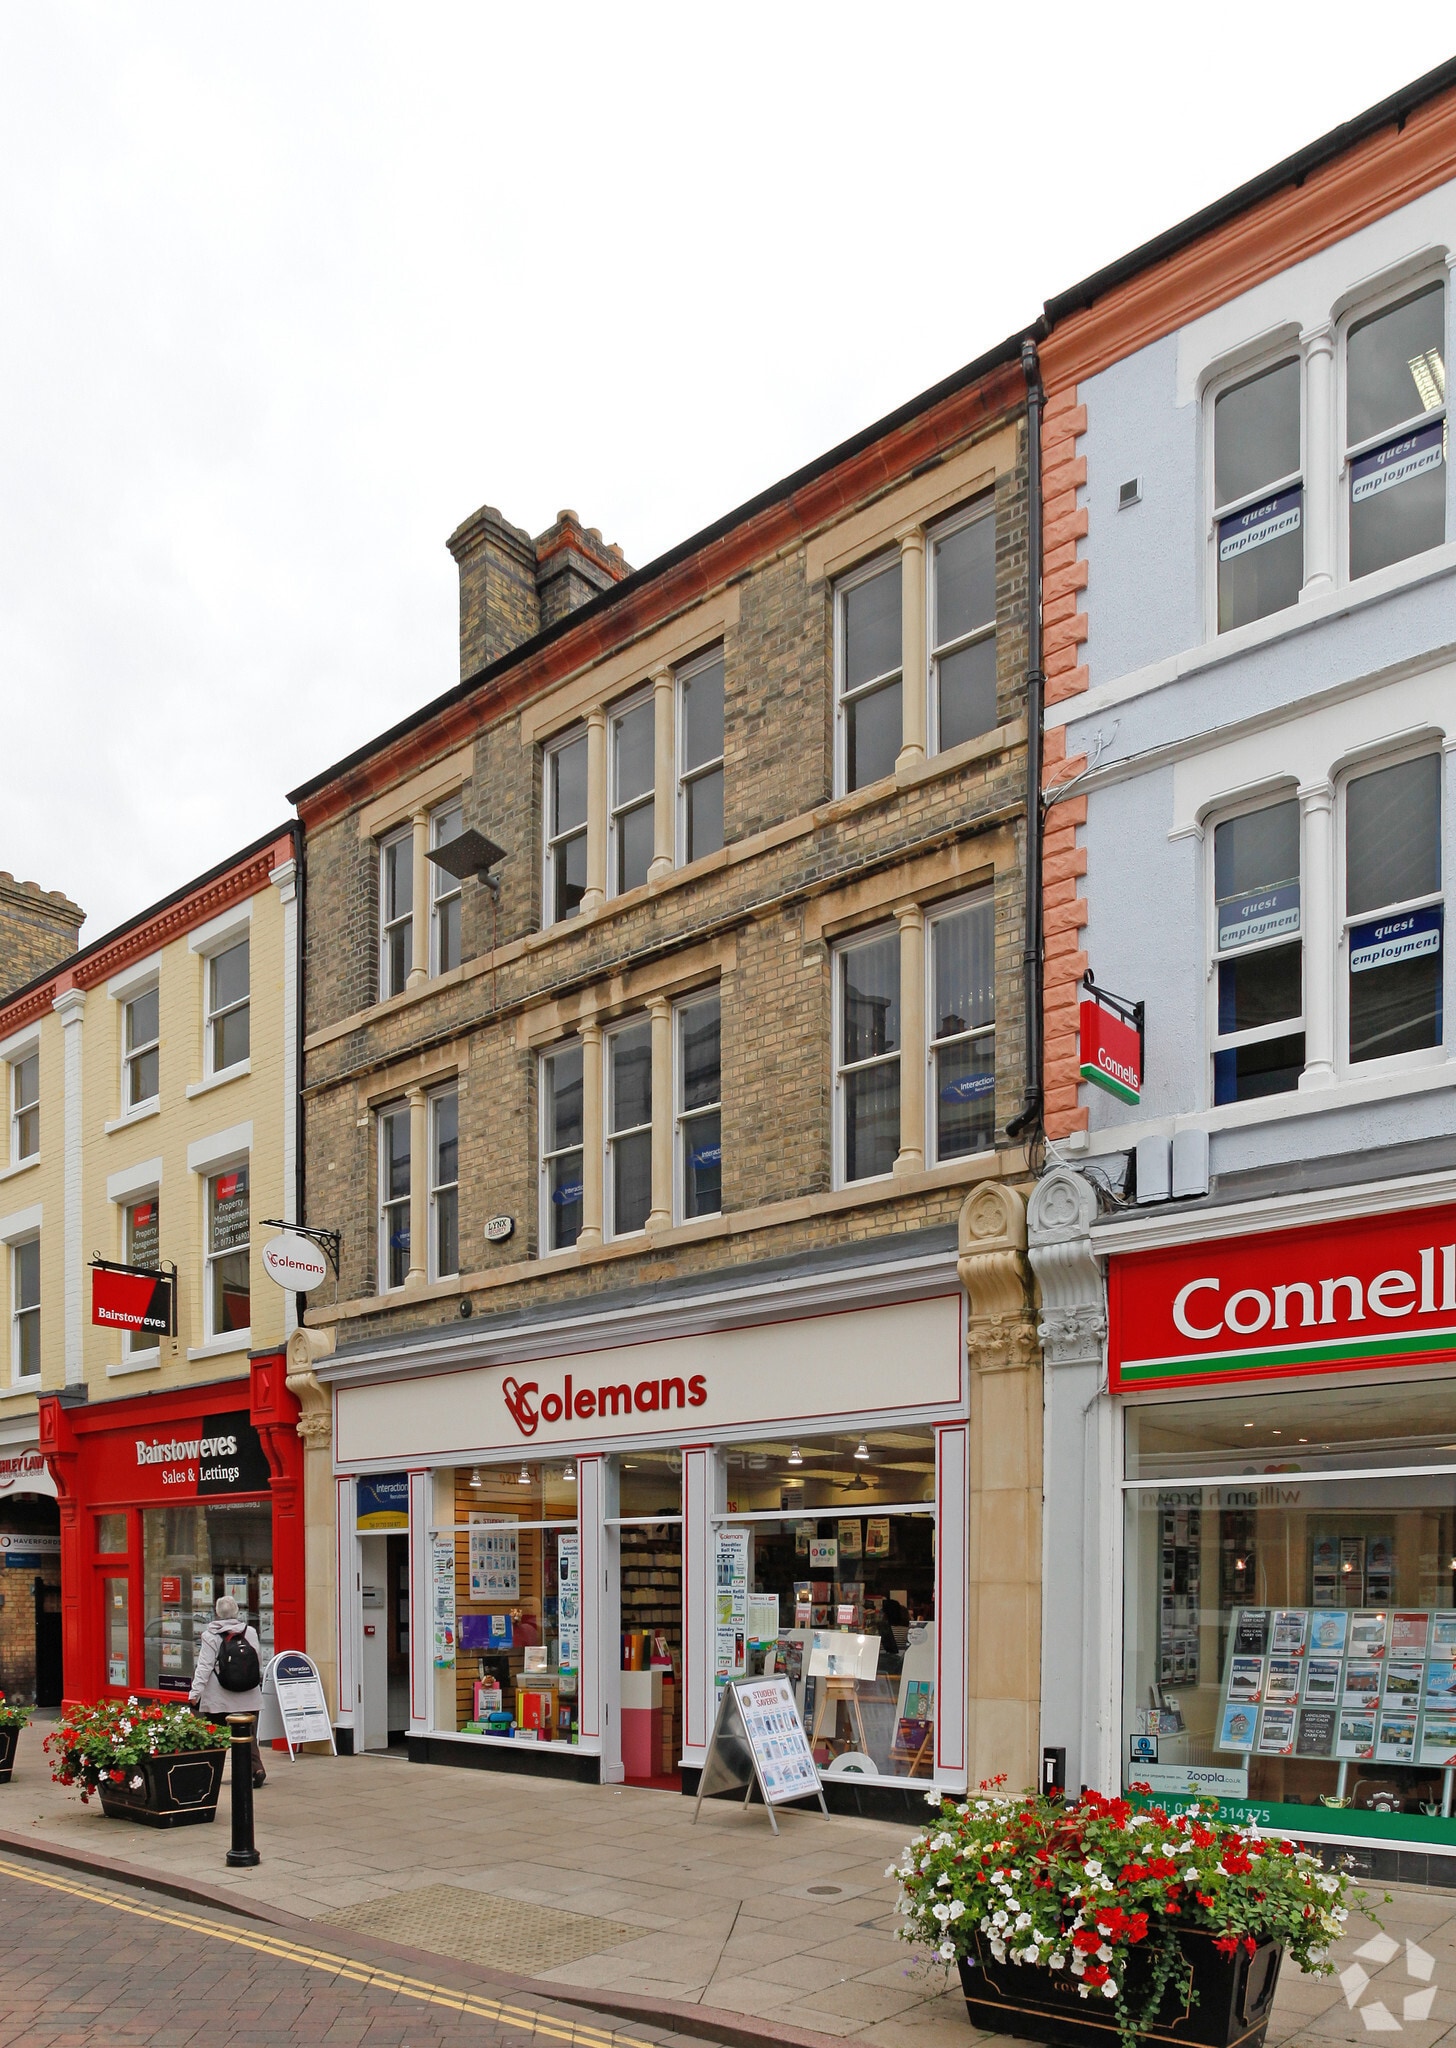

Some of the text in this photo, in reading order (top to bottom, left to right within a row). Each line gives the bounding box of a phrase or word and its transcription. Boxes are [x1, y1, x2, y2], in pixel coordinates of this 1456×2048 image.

[1377, 436, 1417, 465] quest
[1354, 449, 1441, 496] employment
[1241, 500, 1278, 526] quest
[1221, 512, 1299, 555] employment
[1241, 896, 1277, 917] quest
[1221, 912, 1298, 942] employment
[1374, 917, 1415, 939] quest
[1352, 935, 1438, 965] employment
[1097, 1047, 1139, 1088] Connells
[960, 1076, 995, 1091] Interaction
[218, 1199, 244, 1212] Property
[214, 1208, 249, 1225] Management
[488, 1219, 507, 1231] LYNX
[135, 1227, 157, 1239] Property
[214, 1220, 249, 1236] Department
[266, 1250, 325, 1275] Colemans
[1172, 1243, 1456, 1340] Connell
[502, 1374, 708, 1438] Colemans
[24, 1455, 45, 1471] LAW
[162, 1464, 240, 1484] Sales & Lettings
[376, 1481, 408, 1493] Interaction
[719, 1532, 744, 1540] Colemans
[752, 1688, 777, 1699] STUDENT
[756, 1697, 778, 1708] SAVERS!
[1220, 1806, 1270, 1822] 314775
